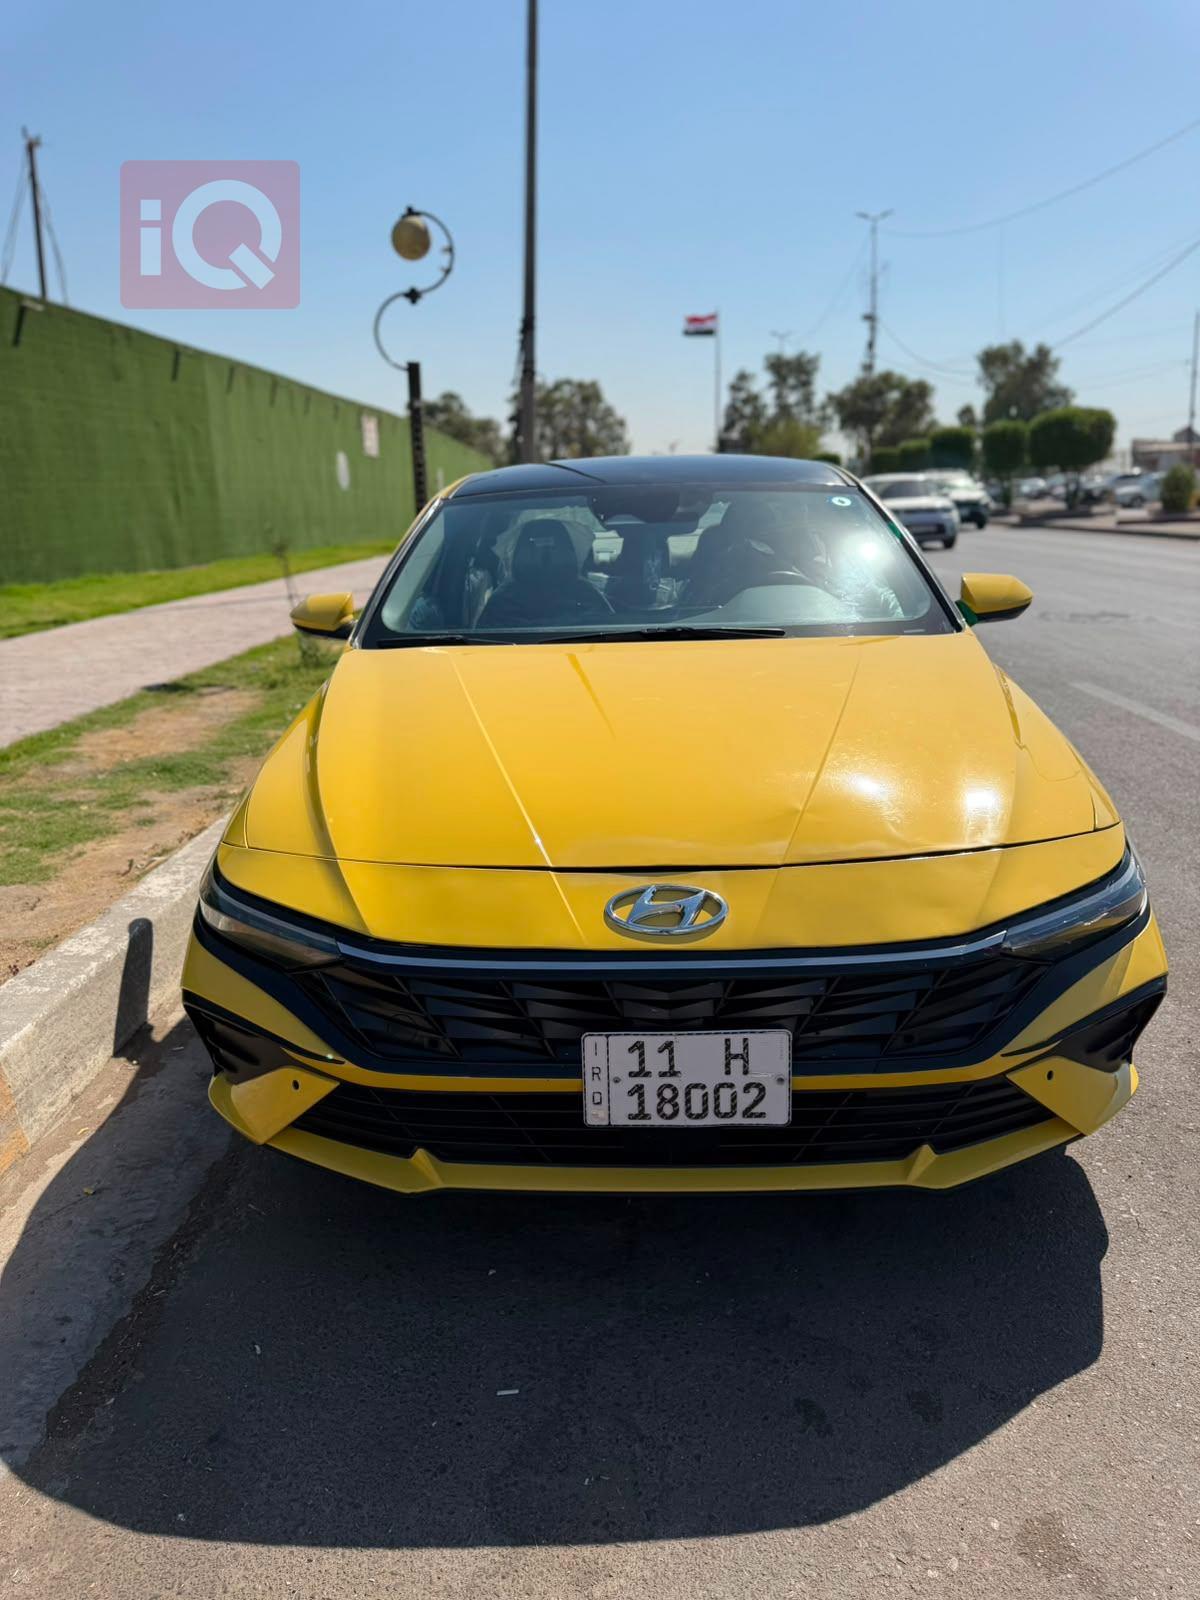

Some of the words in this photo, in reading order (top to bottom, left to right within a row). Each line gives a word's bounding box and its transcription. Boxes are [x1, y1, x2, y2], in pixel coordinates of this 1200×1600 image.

[628, 1040, 681, 1078] 11
[724, 1037, 749, 1075] H
[627, 1082, 767, 1120] 18002
